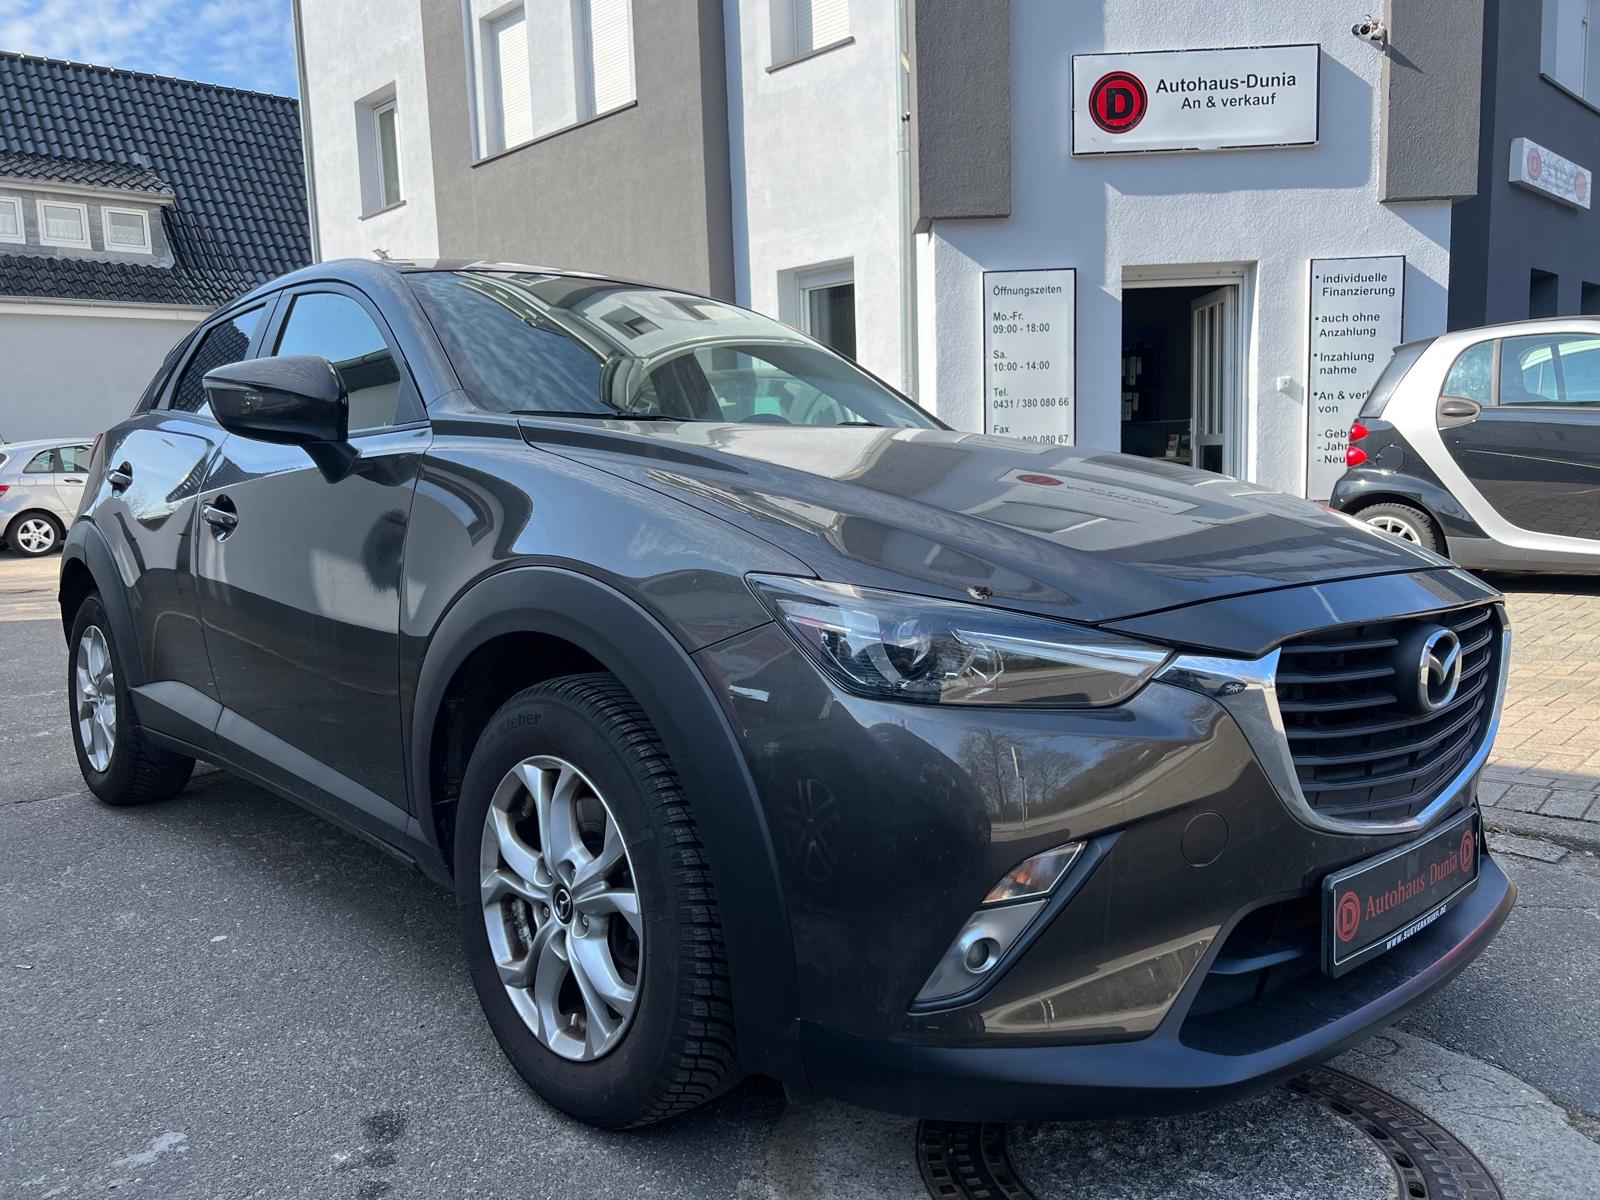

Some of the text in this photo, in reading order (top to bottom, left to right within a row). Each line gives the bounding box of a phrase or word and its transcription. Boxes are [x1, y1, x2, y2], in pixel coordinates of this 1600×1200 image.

[1156, 72, 1296, 93] Autohaus-Dunia
[1181, 92, 1276, 110] An & verkauf
[1322, 273, 1387, 284] individuelle
[993, 285, 1062, 297] Öffnungszeiten
[1322, 286, 1395, 298] Finanzierung
[993, 311, 1024, 321] Mo.-Fr.
[1321, 312, 1380, 323] auch ohne
[993, 324, 1017, 334] 09:00
[1026, 323, 1050, 333] 18:00
[1319, 327, 1377, 338] Anzahlung
[993, 350, 1007, 359] Sa.
[1320, 352, 1375, 363] Inzahlung
[993, 362, 1017, 372] 10:00
[1026, 361, 1050, 371] 14:00
[1319, 365, 1357, 375] nahme
[993, 387, 1008, 397] Tel.
[1318, 391, 1334, 401] An
[1337, 390, 1346, 400] &
[993, 400, 1014, 409] 0431
[1022, 398, 1038, 408] 380
[1040, 398, 1056, 407] 080
[1058, 397, 1069, 407] 66
[1318, 404, 1338, 414] von
[993, 424, 1010, 434] Fax
[1058, 434, 1069, 444] 67
[1365, 874, 1426, 920] Autohaus
[1429, 852, 1458, 886] Dunia
